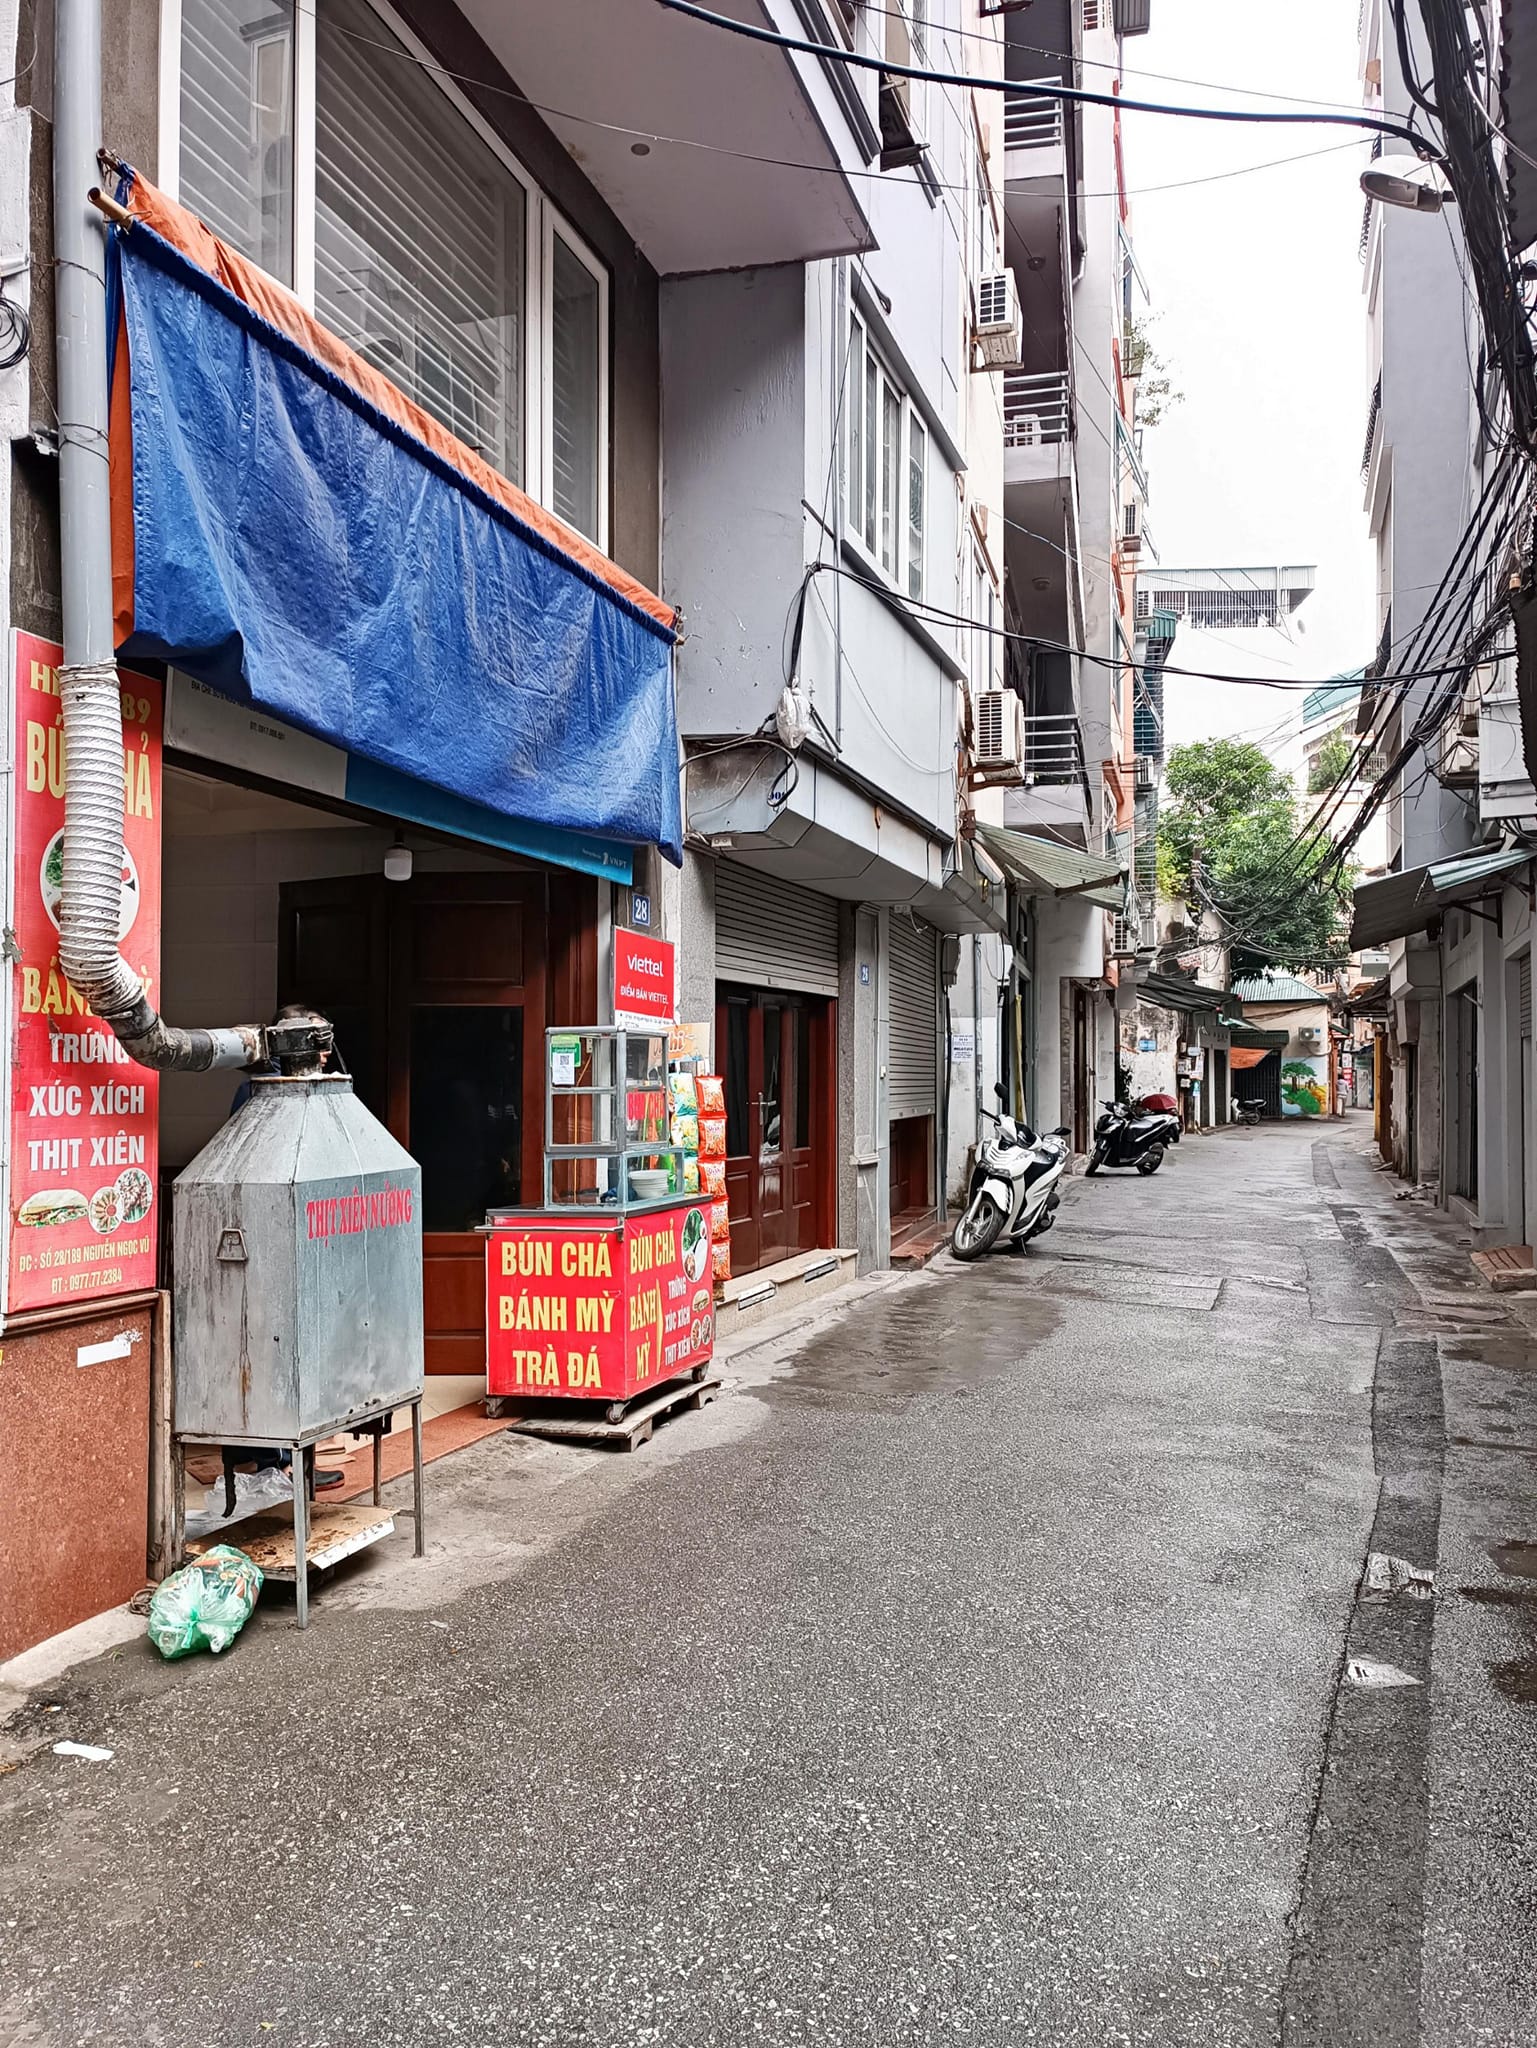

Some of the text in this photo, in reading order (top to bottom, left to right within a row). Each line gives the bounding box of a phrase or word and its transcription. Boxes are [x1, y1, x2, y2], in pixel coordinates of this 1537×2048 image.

[26, 713, 153, 820] BÚ HẢ
[635, 898, 648, 921] 28
[22, 955, 95, 1017] BÁN
[636, 987, 648, 1001] BÁN
[648, 991, 669, 1005] VIETTEL
[49, 1027, 130, 1064] TRỨNG
[29, 1079, 145, 1117] XÚC XÍCH
[27, 1129, 145, 1176] THỊT XIÊN
[306, 1198, 337, 1248] THỊT
[339, 1184, 368, 1235] XIÊN
[54, 1248, 82, 1267] 28/189
[117, 1239, 138, 1259] NGỌC
[501, 1233, 612, 1278] BÚN CHẢ
[630, 1217, 676, 1276] BÚN CHẢ
[499, 1288, 615, 1333] BÁNH MỲ
[629, 1283, 657, 1333] BÁNH
[665, 1304, 691, 1334] XÚC XÍCH
[512, 1344, 602, 1389] TRÀ ĐÁ
[636, 1332, 651, 1382] MỲ
[665, 1342, 677, 1368] THỊT
